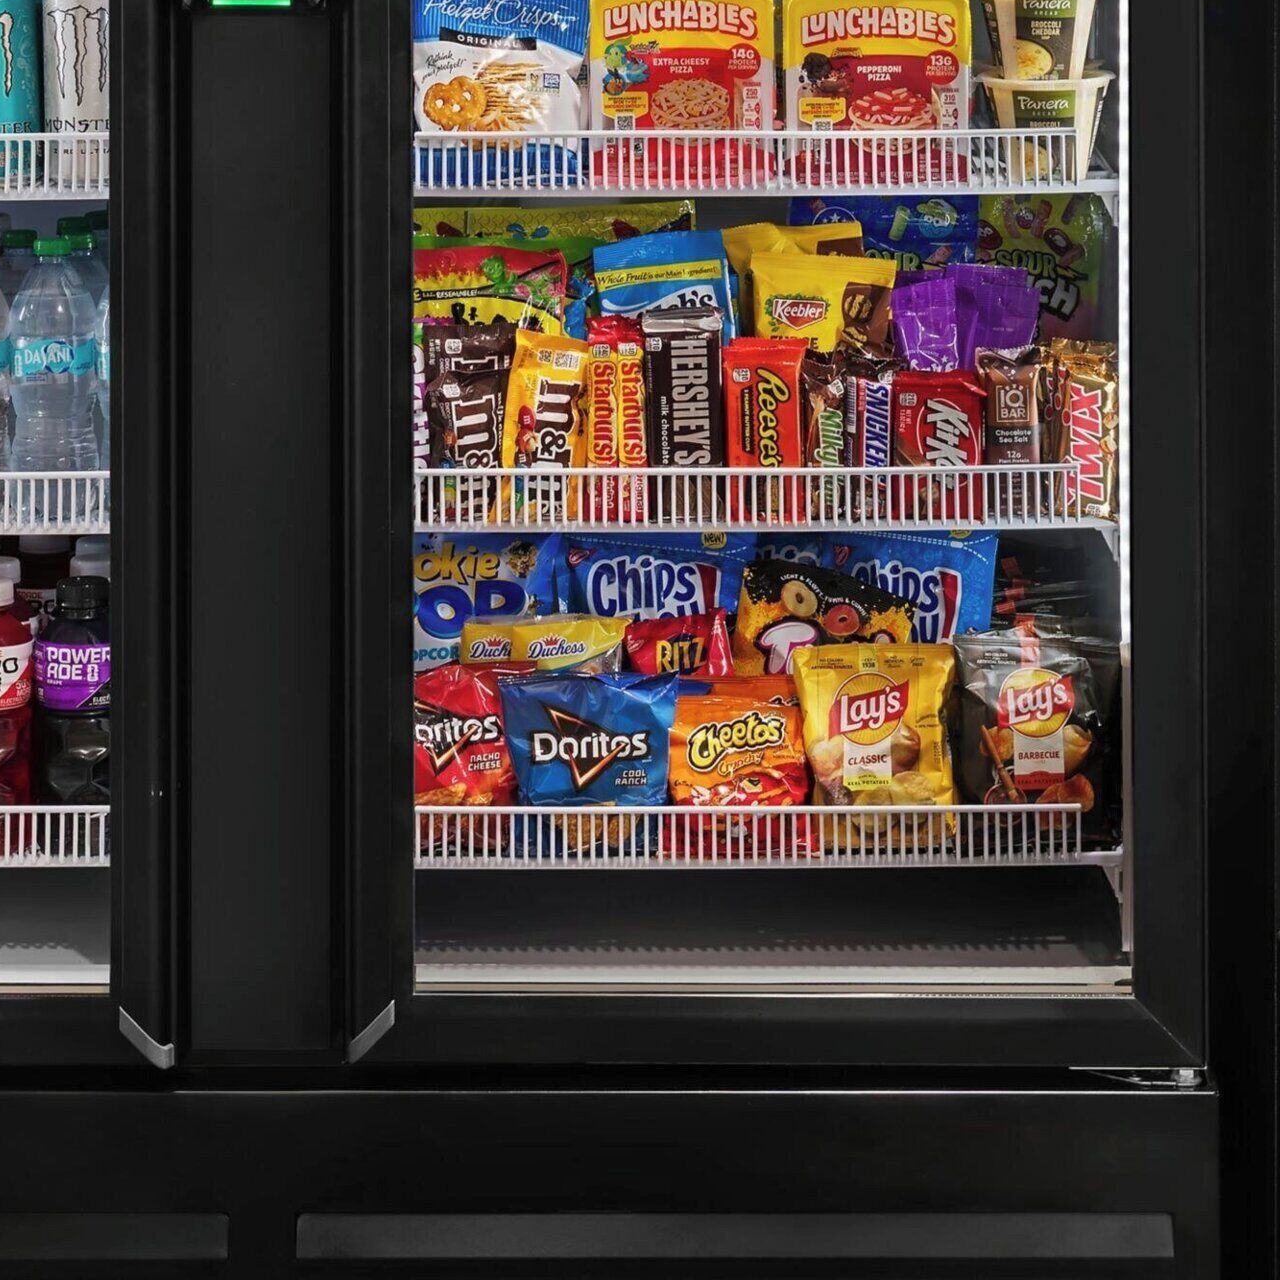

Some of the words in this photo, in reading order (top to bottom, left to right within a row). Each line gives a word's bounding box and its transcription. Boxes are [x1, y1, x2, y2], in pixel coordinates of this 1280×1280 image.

[800, 7, 958, 48] LUNCHABLES
[457, 34, 520, 48] ORIGINAL
[652, 58, 679, 67] EXTRA
[680, 57, 710, 66] CHEESY
[670, 65, 694, 74] PIZZA
[728, 58, 758, 66] PROTEIN
[857, 65, 902, 74] PEPPERONI
[926, 64, 956, 72] PROTEIN
[867, 73, 891, 82] PIZZA
[1017, 96, 1069, 112] Panera
[773, 299, 823, 322] Keebler
[24, 347, 71, 365] DASANI
[592, 362, 616, 466] Starburst
[621, 358, 647, 467] Starburst
[660, 396, 668, 418] milk
[670, 338, 711, 468] HERSHEY'S
[660, 419, 669, 465] chocolate
[995, 429, 1032, 437] Chocolate
[1070, 380, 1103, 502] TWIX
[589, 558, 698, 620] Chips
[528, 639, 586, 659] Duchess
[657, 637, 707, 674] RITZ
[840, 685, 902, 733] Lay's
[1009, 679, 1071, 724] Lay's
[533, 732, 649, 764] Doritos
[688, 711, 785, 772] Cheetos
[847, 754, 887, 766] CLASSIC
[1018, 750, 1061, 761] BARBECUE
